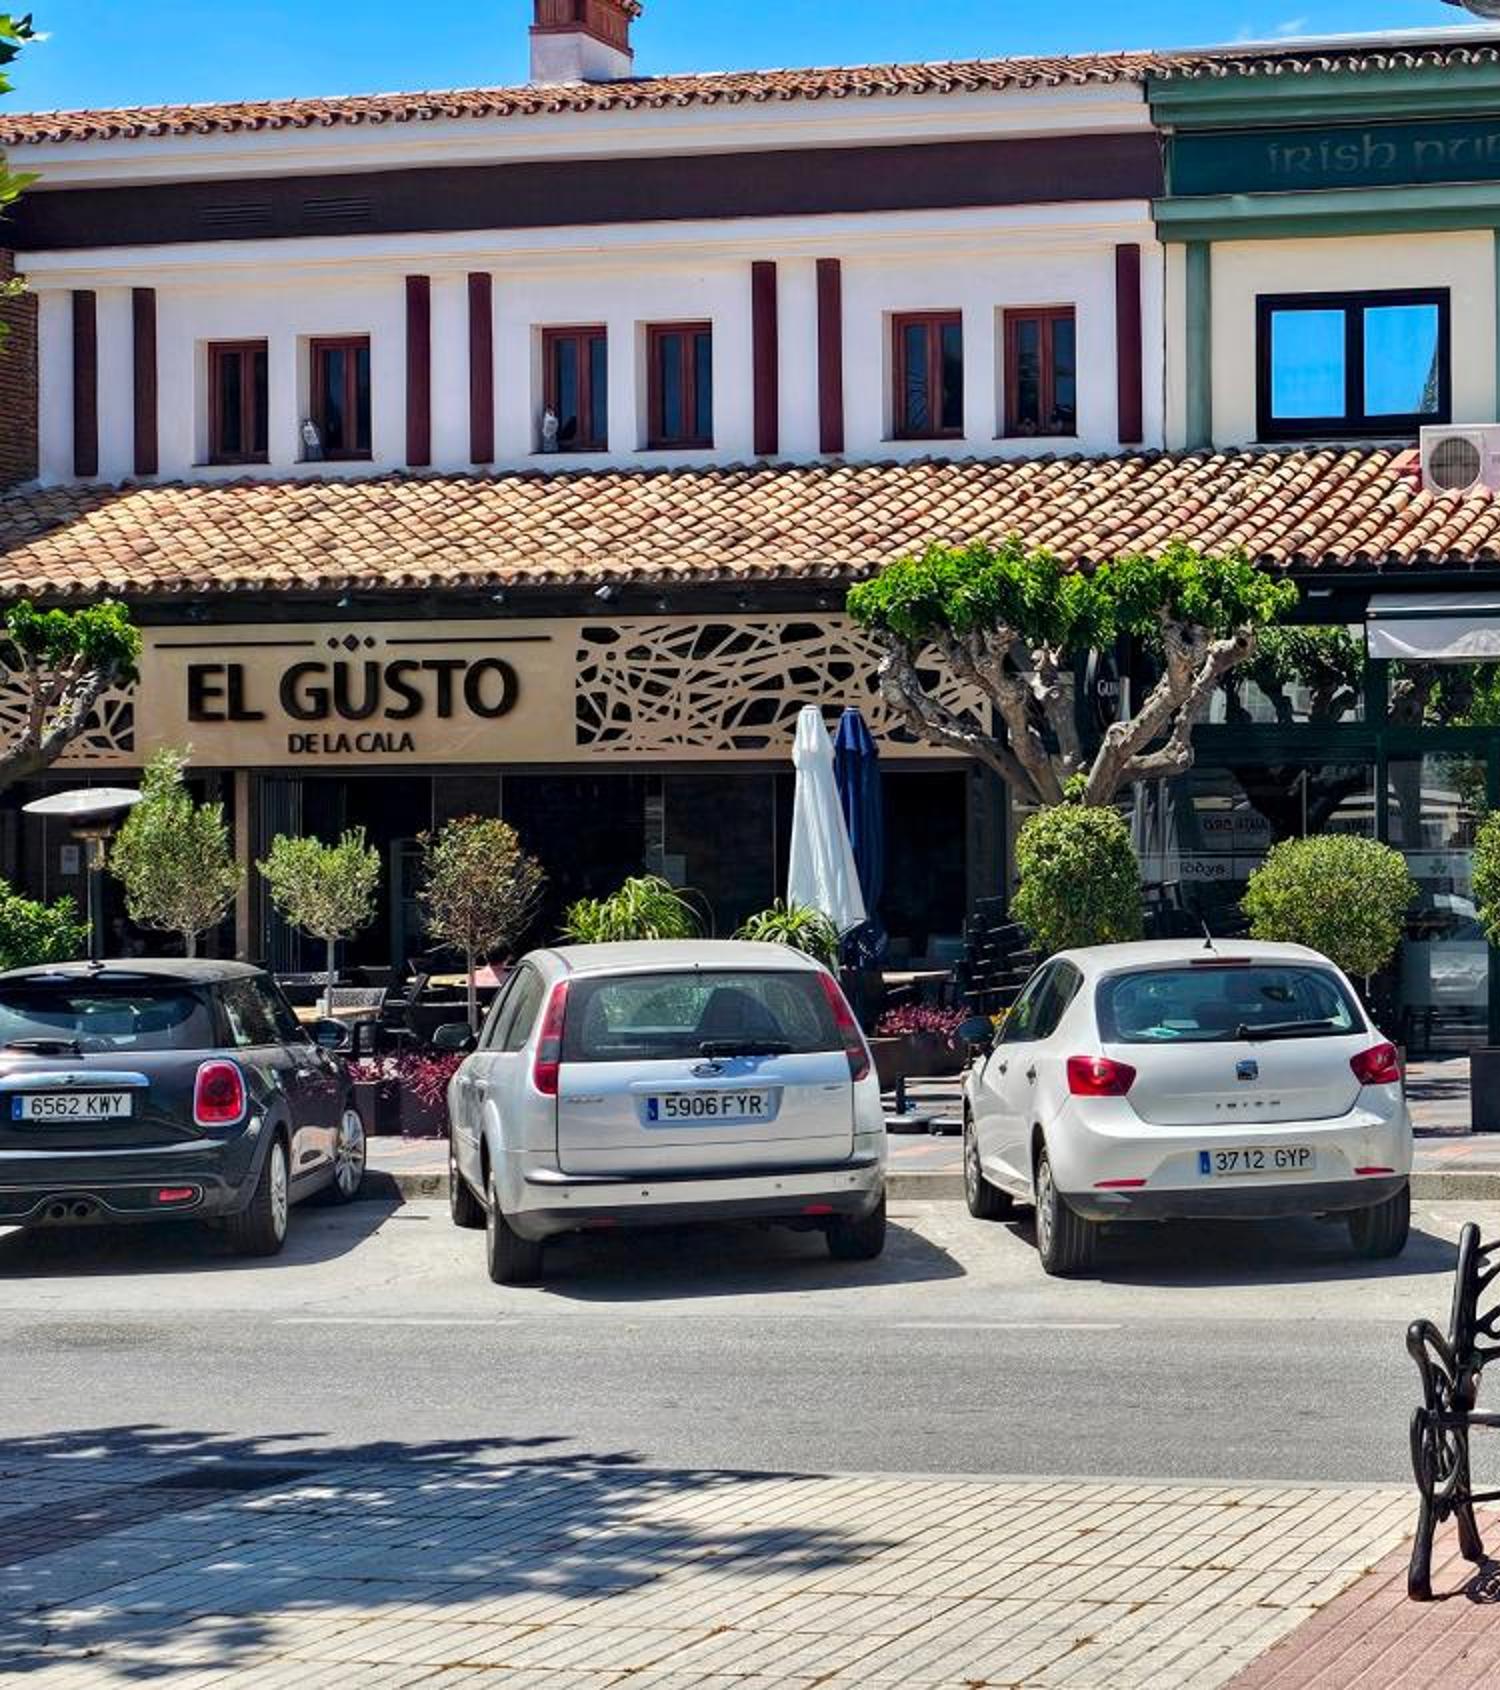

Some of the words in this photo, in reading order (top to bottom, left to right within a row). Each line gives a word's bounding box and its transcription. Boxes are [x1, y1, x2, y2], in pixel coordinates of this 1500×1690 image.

[187, 663, 266, 722] EL
[278, 657, 521, 722] GUSTO
[287, 734, 319, 753] DE
[322, 733, 352, 753] LA
[354, 732, 416, 752] CALA
[31, 1097, 80, 1115] 6562
[86, 1095, 122, 1114] KWY
[664, 1097, 718, 1118] 5906
[723, 1094, 763, 1115] FYR
[1214, 1150, 1265, 1171] 3712
[1273, 1147, 1312, 1168] GYP
